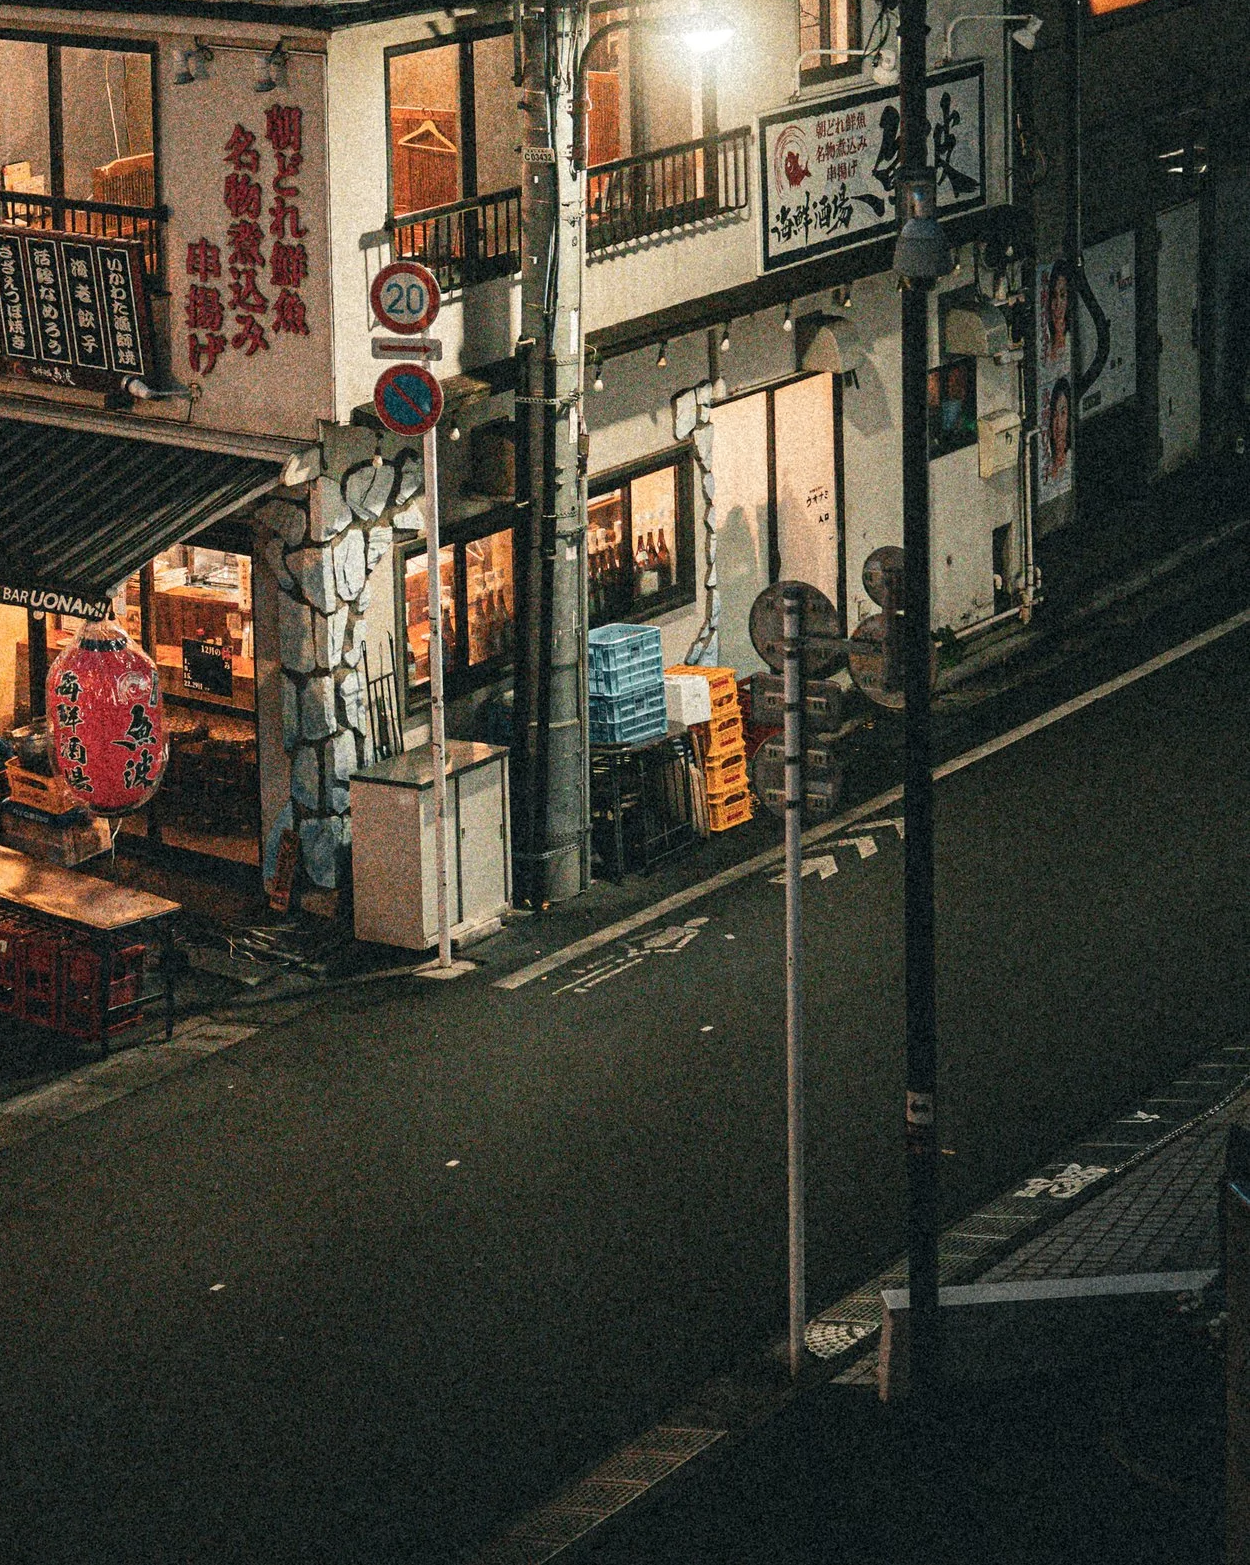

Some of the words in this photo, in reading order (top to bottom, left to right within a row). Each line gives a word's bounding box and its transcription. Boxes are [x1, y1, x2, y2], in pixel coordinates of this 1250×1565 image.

[815, 112, 867, 139] 朝どれ鮮魚
[826, 160, 858, 183] 串揚げ
[264, 103, 310, 336] 朝どれ鮮魚
[771, 183, 853, 245] 海鮮酒場
[223, 123, 270, 356] 名物煮込み
[185, 237, 227, 376] 串揚げ
[386, 283, 424, 315] 20
[3, 587, 29, 604] BAR
